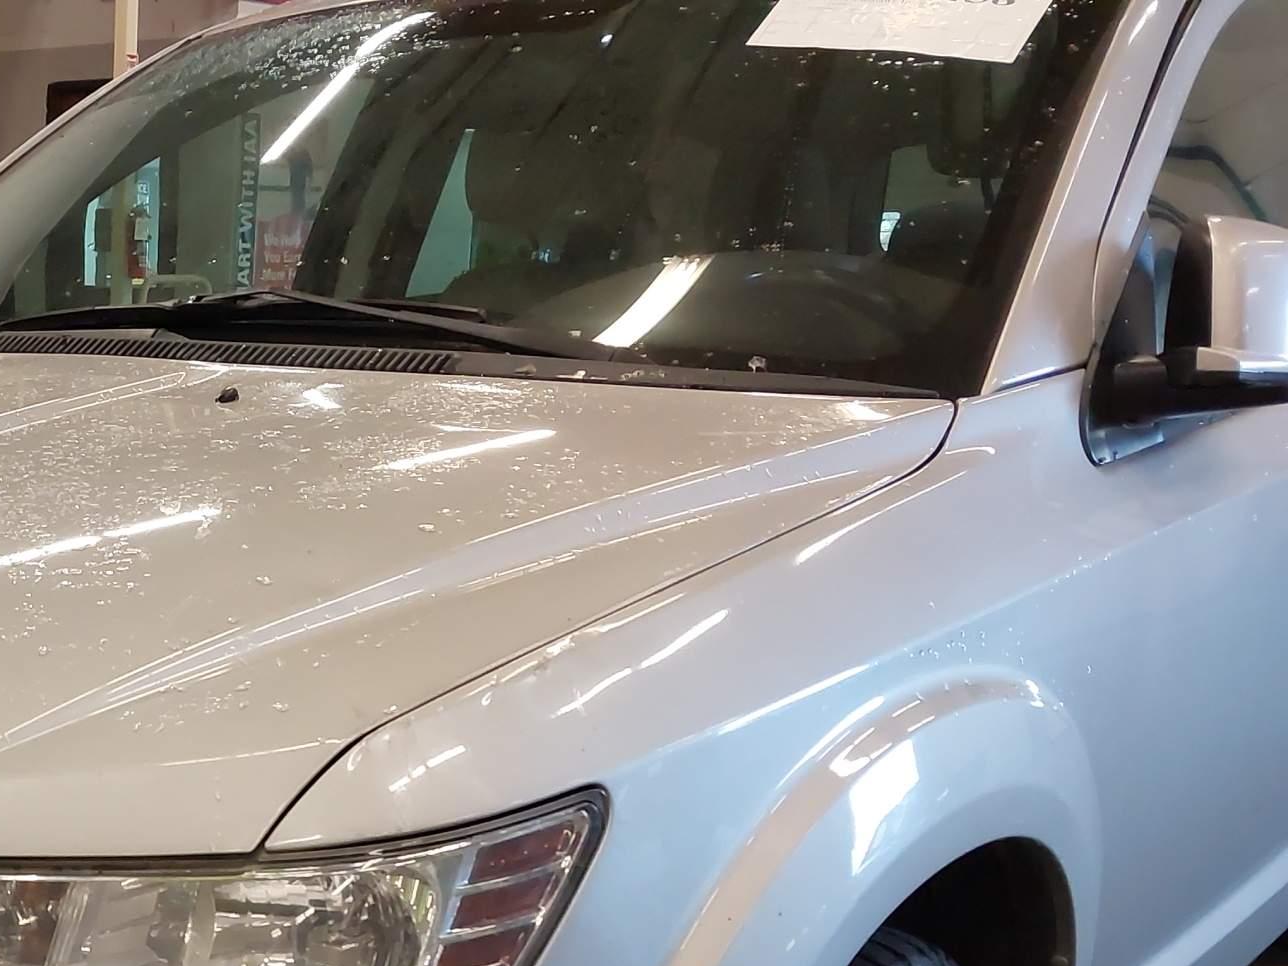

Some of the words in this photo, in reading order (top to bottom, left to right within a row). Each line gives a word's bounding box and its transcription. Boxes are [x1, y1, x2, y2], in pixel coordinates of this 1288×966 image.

[243, 119, 259, 163] IAA
[239, 170, 256, 233] WITH
[236, 239, 252, 292] ART
